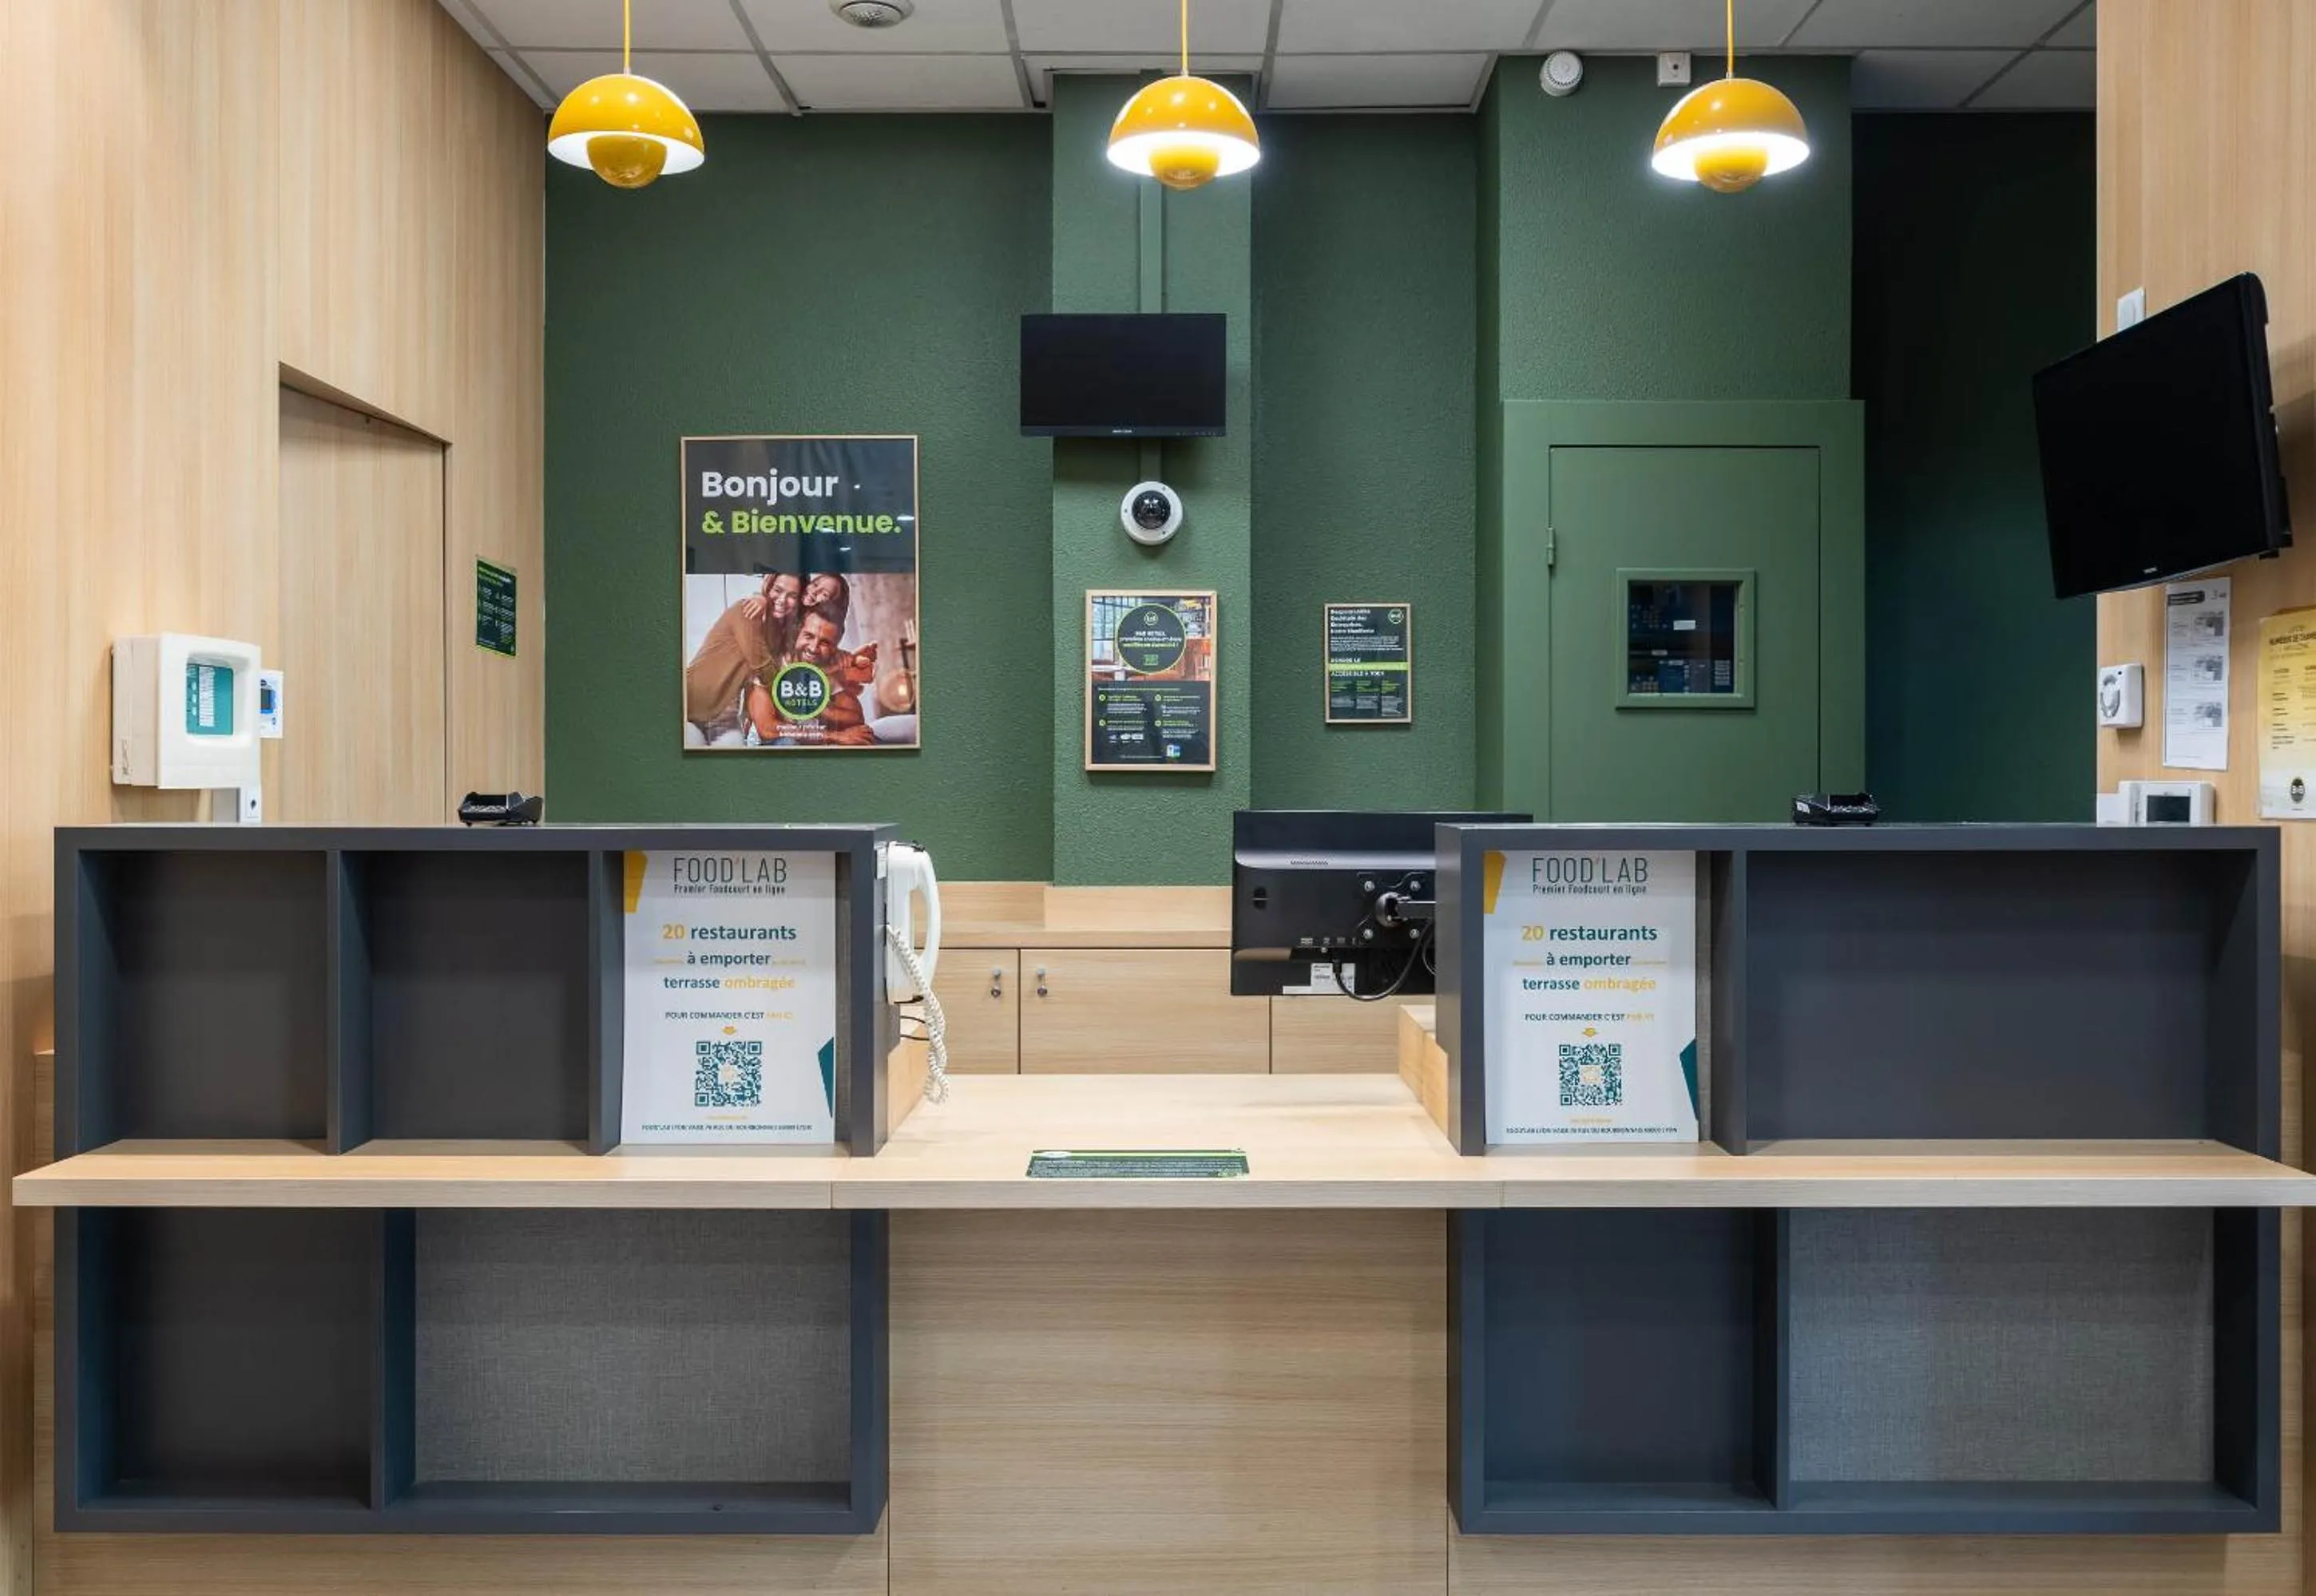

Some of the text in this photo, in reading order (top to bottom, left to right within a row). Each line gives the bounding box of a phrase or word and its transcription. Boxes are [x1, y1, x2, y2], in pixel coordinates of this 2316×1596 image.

[702, 468, 839, 505] Bonjour
[701, 508, 902, 534] & Bienvenue.
[780, 680, 823, 697] B&B
[674, 857, 787, 883] FOOD'LAB
[1533, 857, 1649, 883] FOOD'LAB
[674, 884, 705, 893] Premier
[709, 884, 751, 893] Foodcourt
[765, 884, 786, 896] ligne
[1533, 884, 1565, 894] Premier
[1568, 884, 1610, 894] Foodcourt
[1625, 884, 1647, 896] ligne
[662, 924, 797, 940] 20 restaurants
[1521, 925, 1657, 941] 20 restaurants
[687, 951, 771, 968] à emporter
[1546, 952, 1631, 968] à emporter
[664, 976, 795, 991] terrasse ombragée
[1523, 977, 1656, 992] terrasse ombragée
